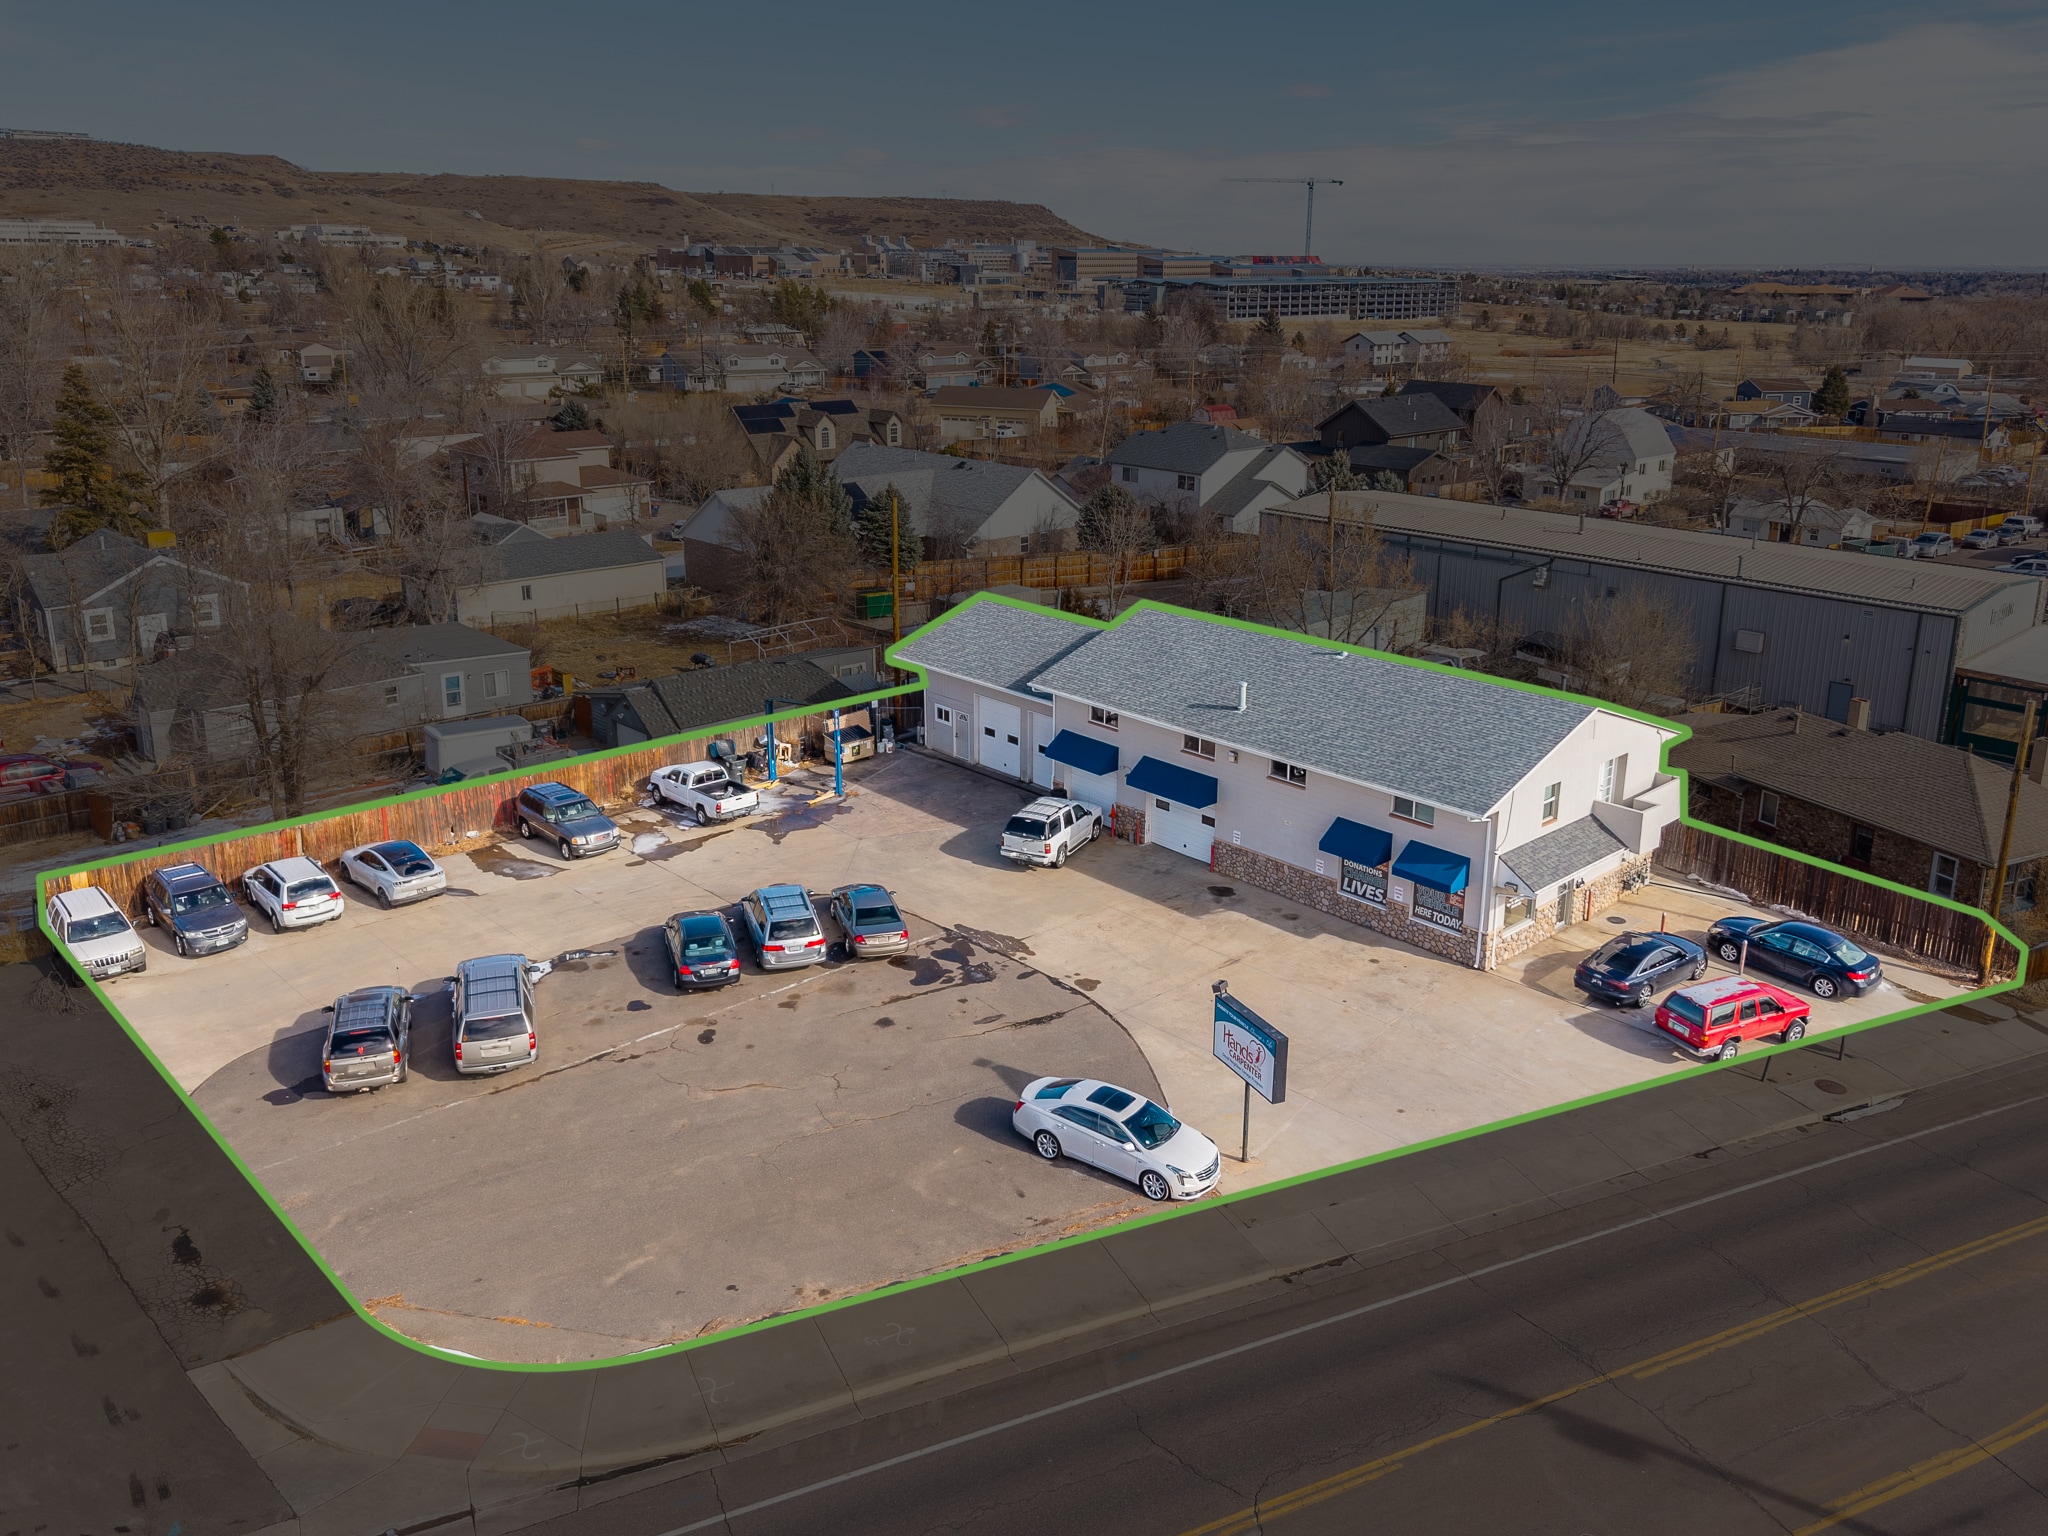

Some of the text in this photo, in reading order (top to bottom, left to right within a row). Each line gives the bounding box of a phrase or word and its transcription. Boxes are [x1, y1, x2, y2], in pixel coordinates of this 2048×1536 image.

[1343, 859, 1383, 878] DONATIONS
[1343, 866, 1388, 890] CHANGE
[1342, 877, 1387, 904] LIVES.
[1416, 884, 1446, 903] YOUR
[1414, 905, 1463, 931] HERE TODAY.
[1416, 894, 1459, 917] VEHICLE
[1222, 1023, 1254, 1065] Hands
[1228, 1049, 1262, 1081] CARPENTER
